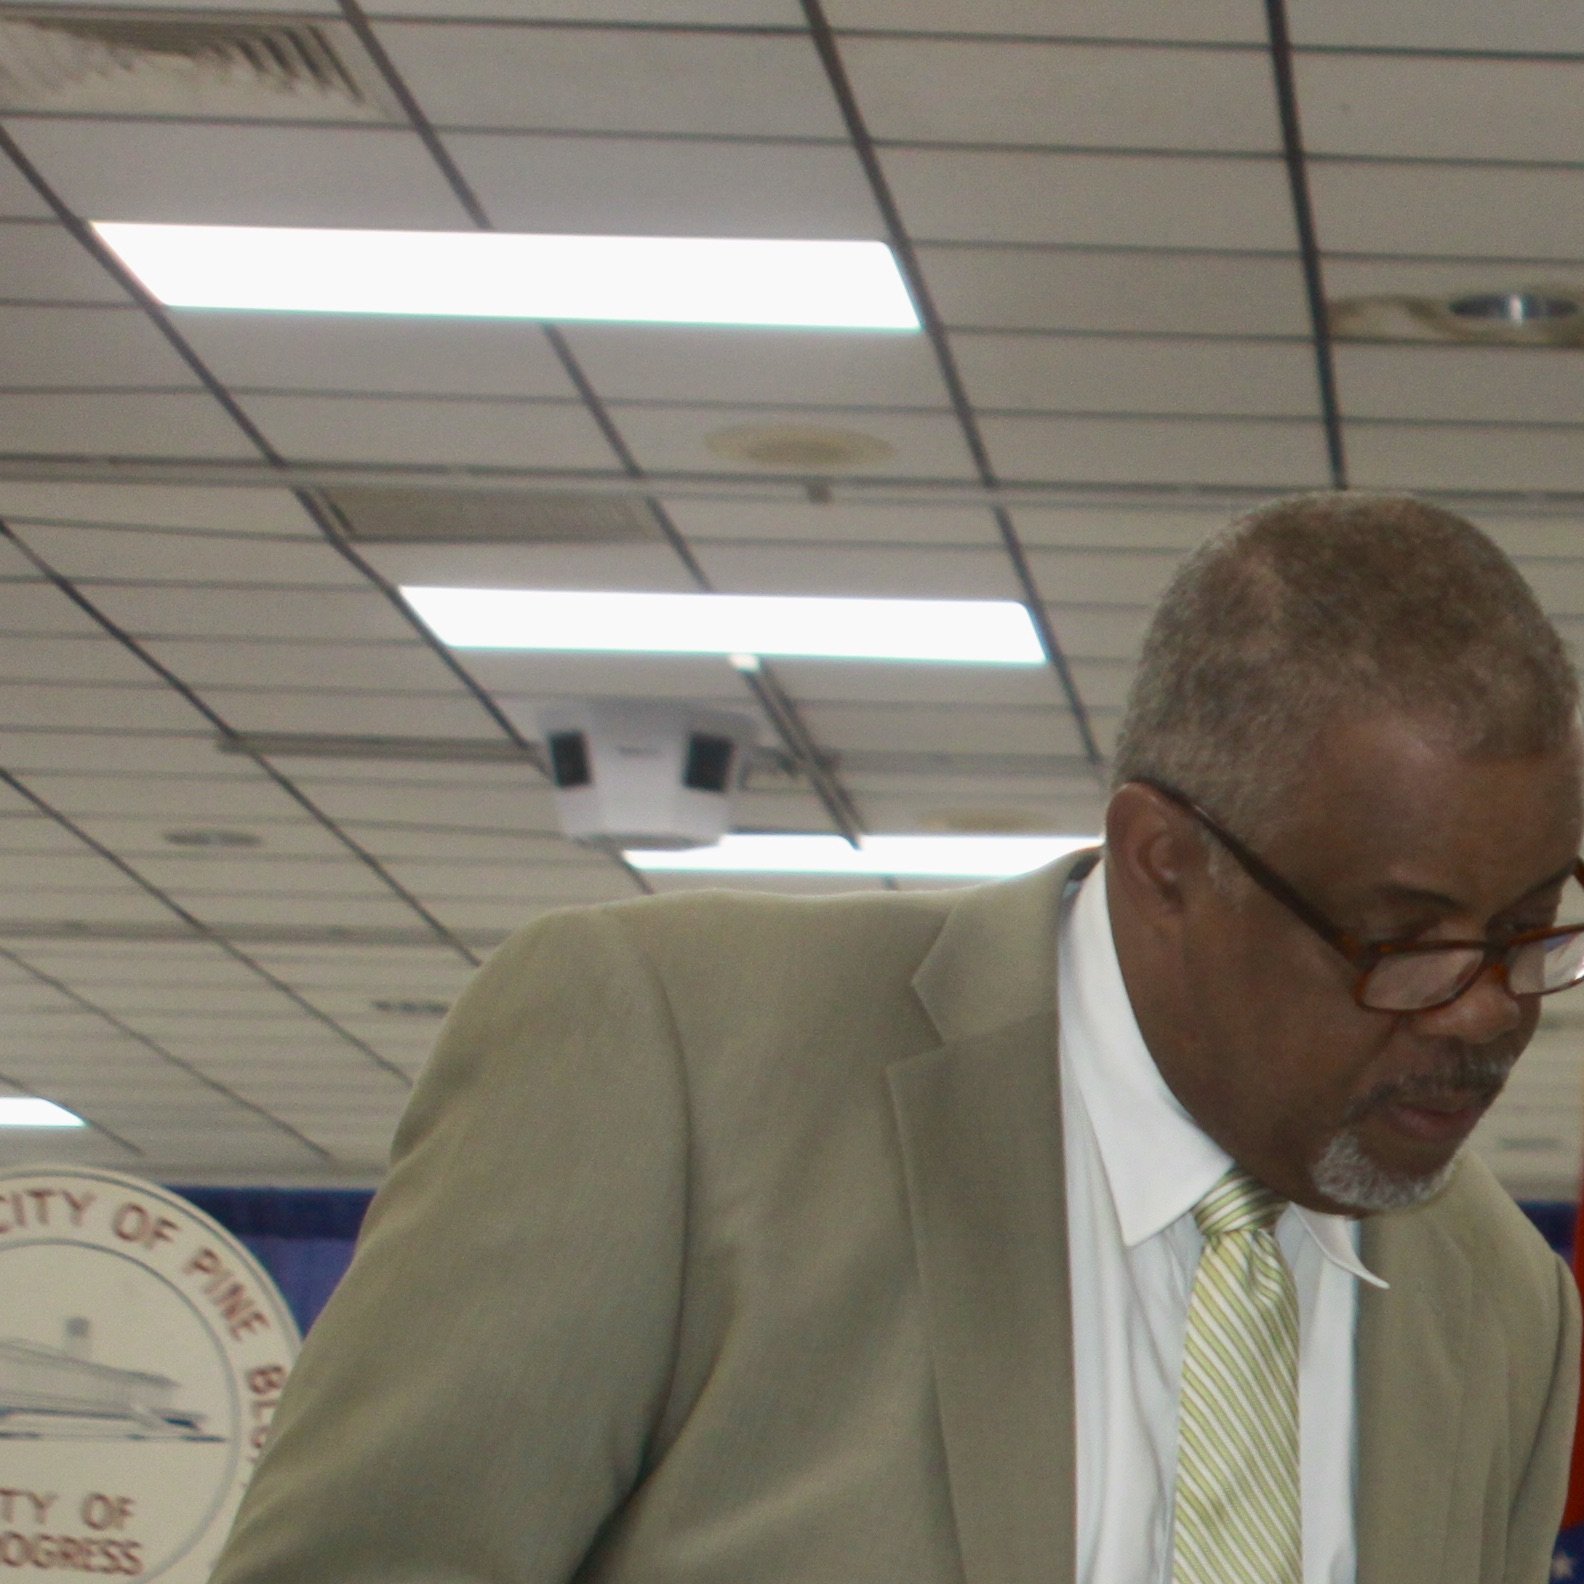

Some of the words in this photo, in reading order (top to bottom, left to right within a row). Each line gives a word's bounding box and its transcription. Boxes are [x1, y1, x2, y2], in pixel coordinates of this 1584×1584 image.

[111, 1200, 182, 1251] OF
[183, 1246, 271, 1343] PINE
[83, 1492, 137, 1531] OF
